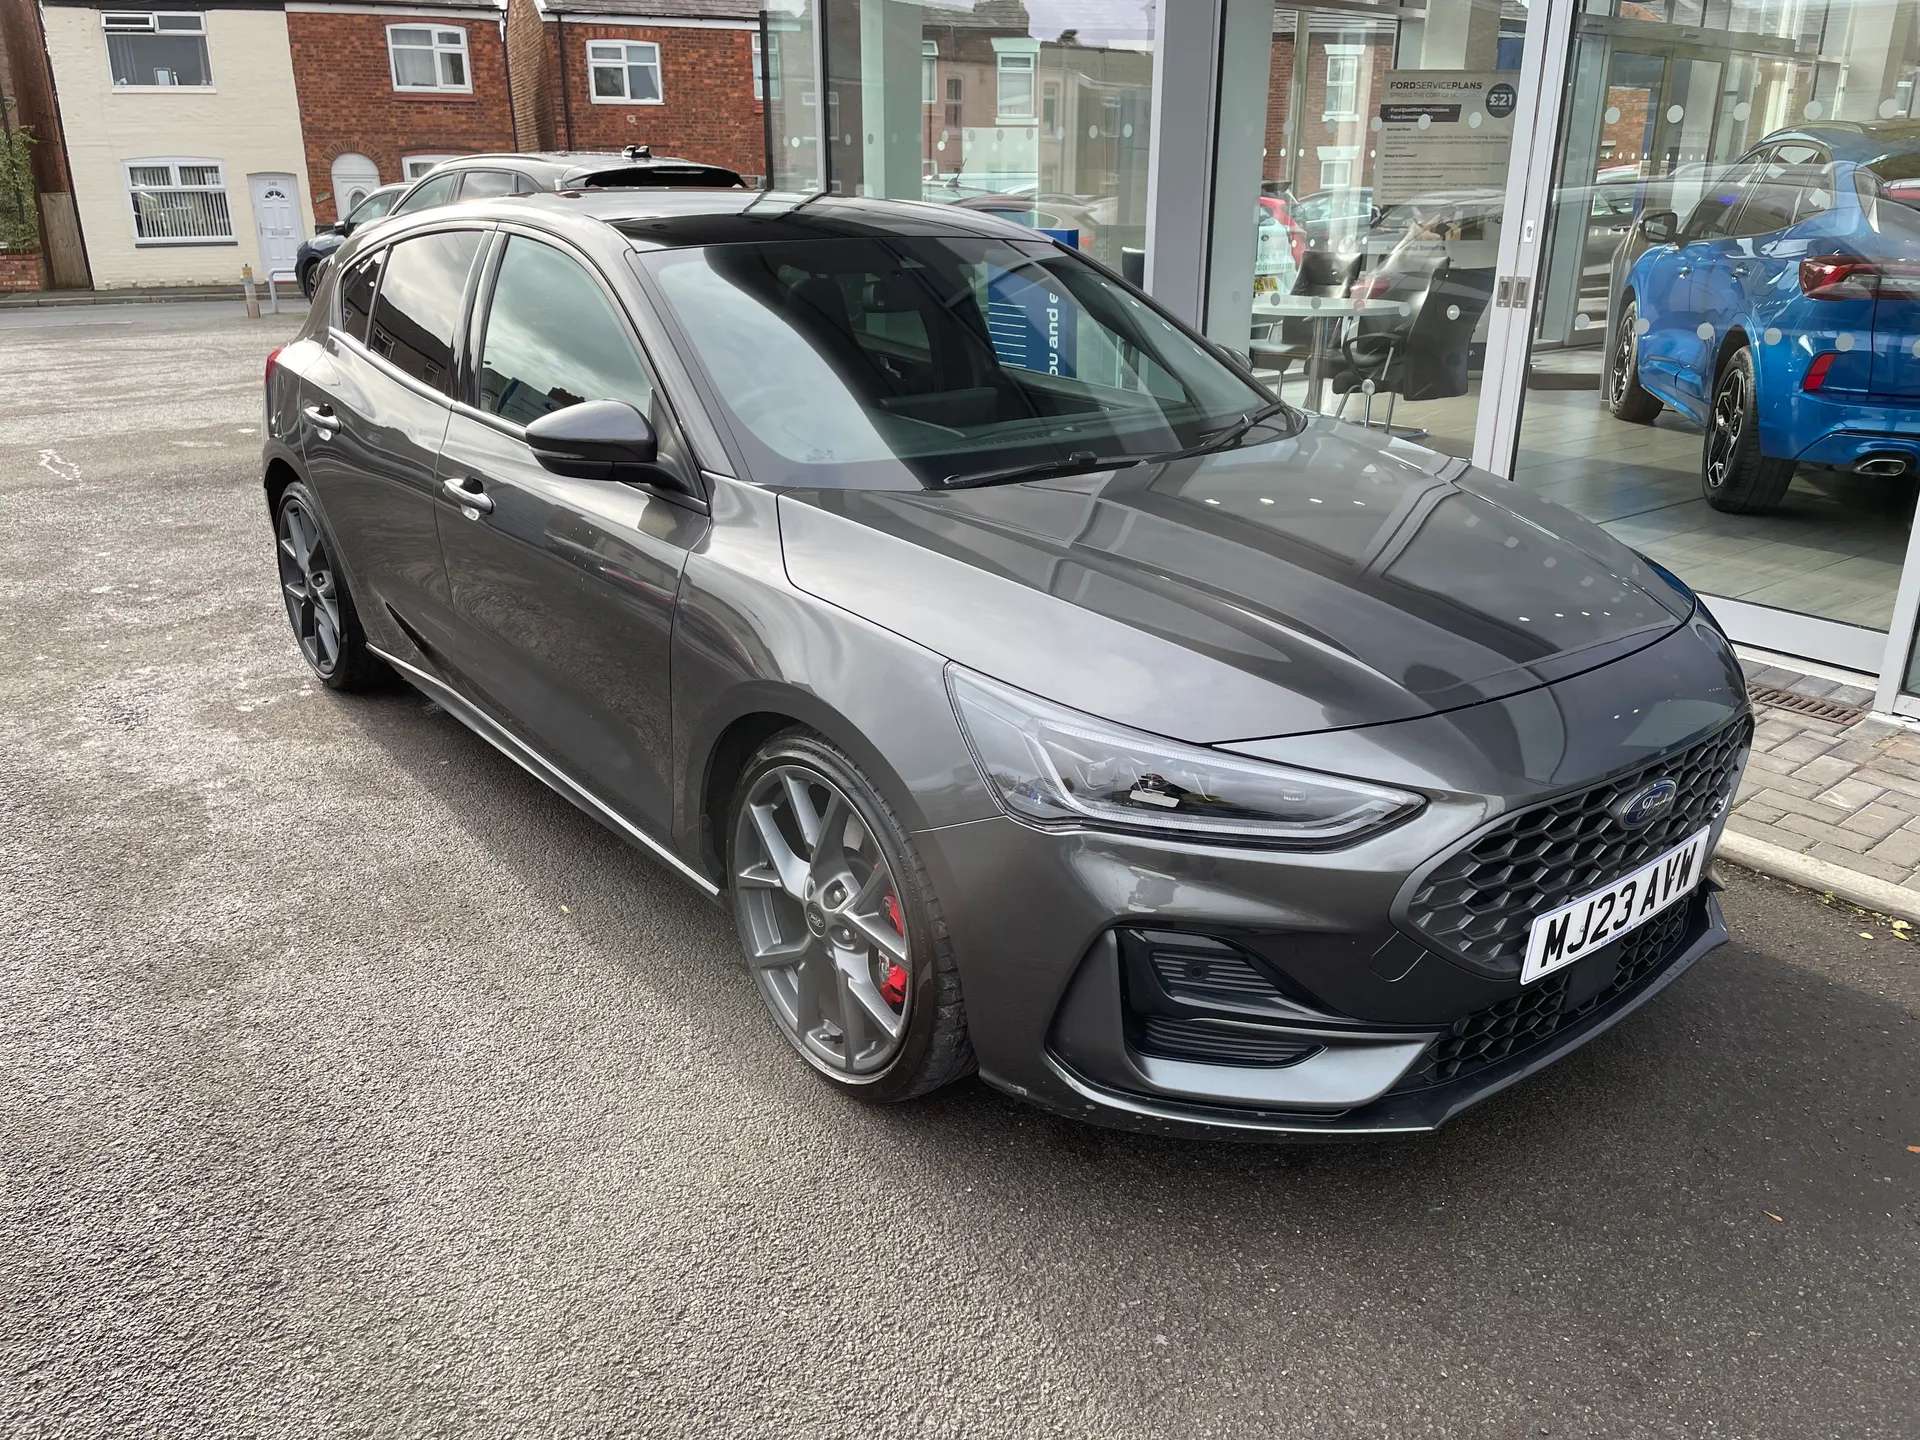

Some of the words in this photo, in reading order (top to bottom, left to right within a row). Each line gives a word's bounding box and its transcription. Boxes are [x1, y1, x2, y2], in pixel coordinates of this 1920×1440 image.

[1390, 81, 1483, 90] FORDSERVICEPLANS
[1489, 94, 1513, 106] £21
[1046, 307, 1059, 349] and
[1048, 352, 1059, 376] ou
[1637, 790, 1672, 820] Ford
[1540, 880, 1637, 968] MJ23
[1639, 842, 1697, 916] AVW
